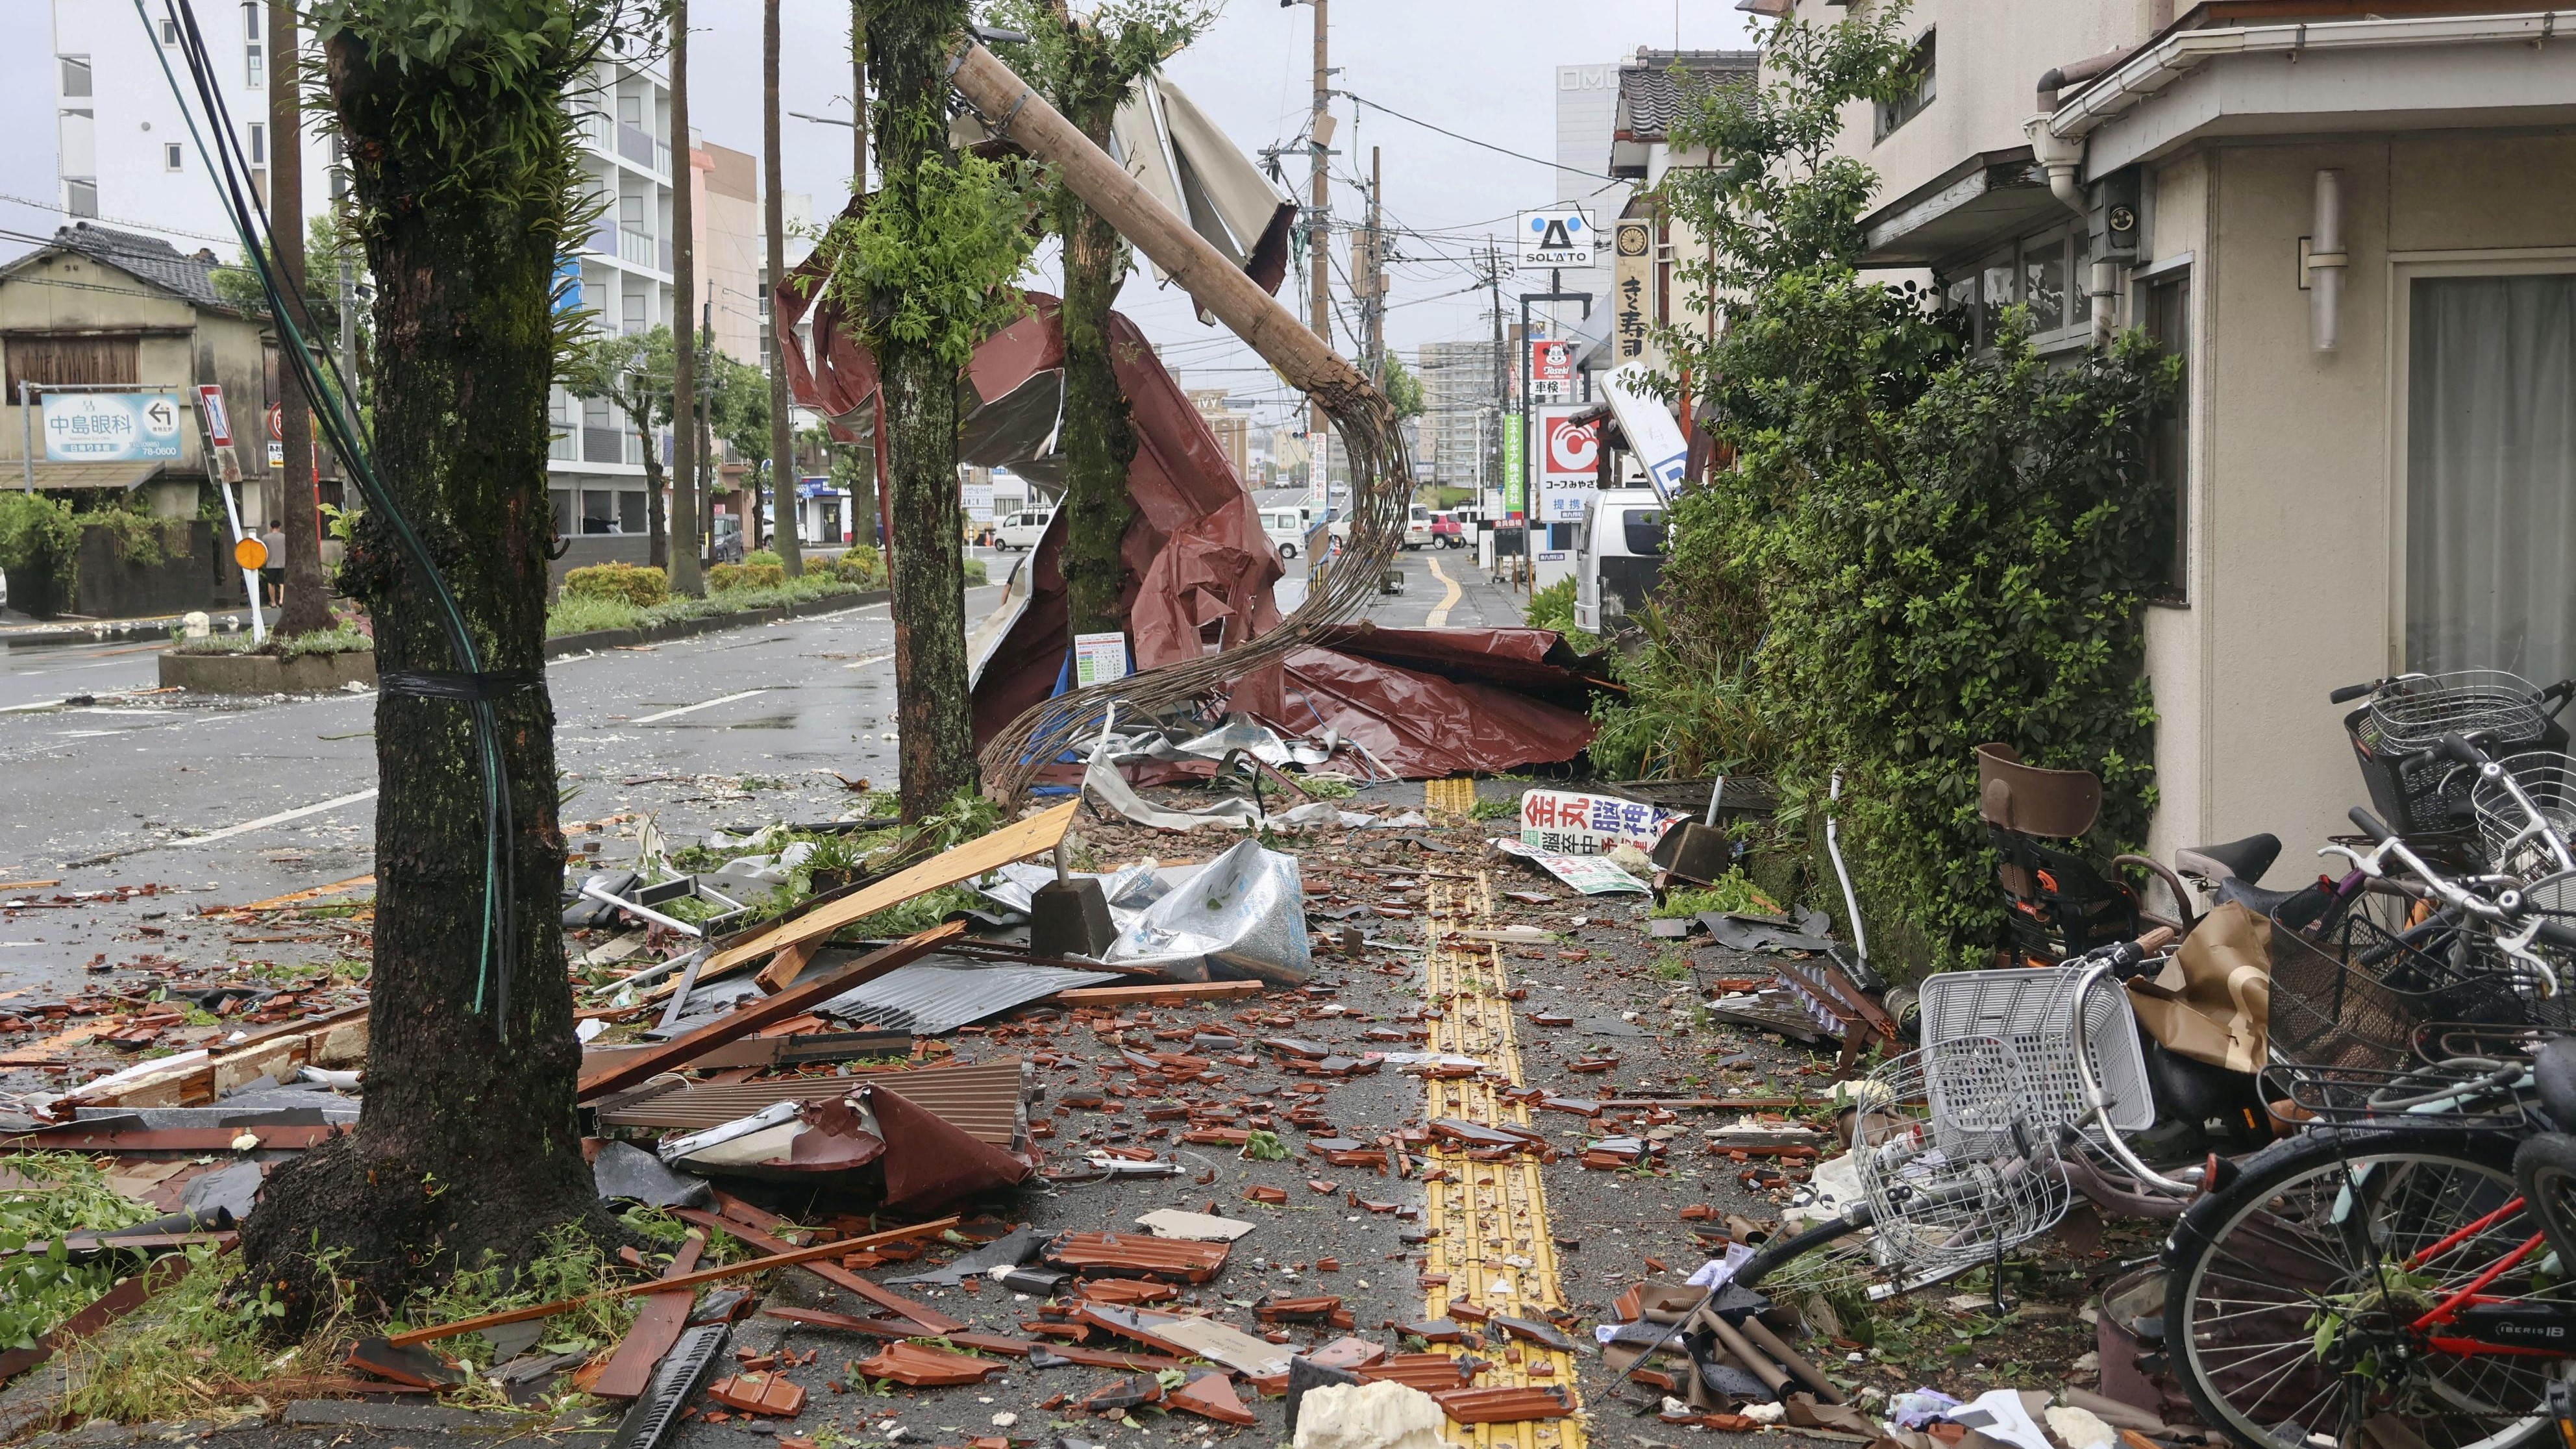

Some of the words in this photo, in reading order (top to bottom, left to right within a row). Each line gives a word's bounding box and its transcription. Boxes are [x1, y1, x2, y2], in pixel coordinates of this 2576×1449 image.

[1535, 380, 1559, 393] 車検
[50, 414, 132, 435] 中島眼科
[143, 447, 177, 456] 78-0600
[1509, 417, 1519, 504] エネルギア株式会社
[1546, 480, 1598, 489] コープみやざ
